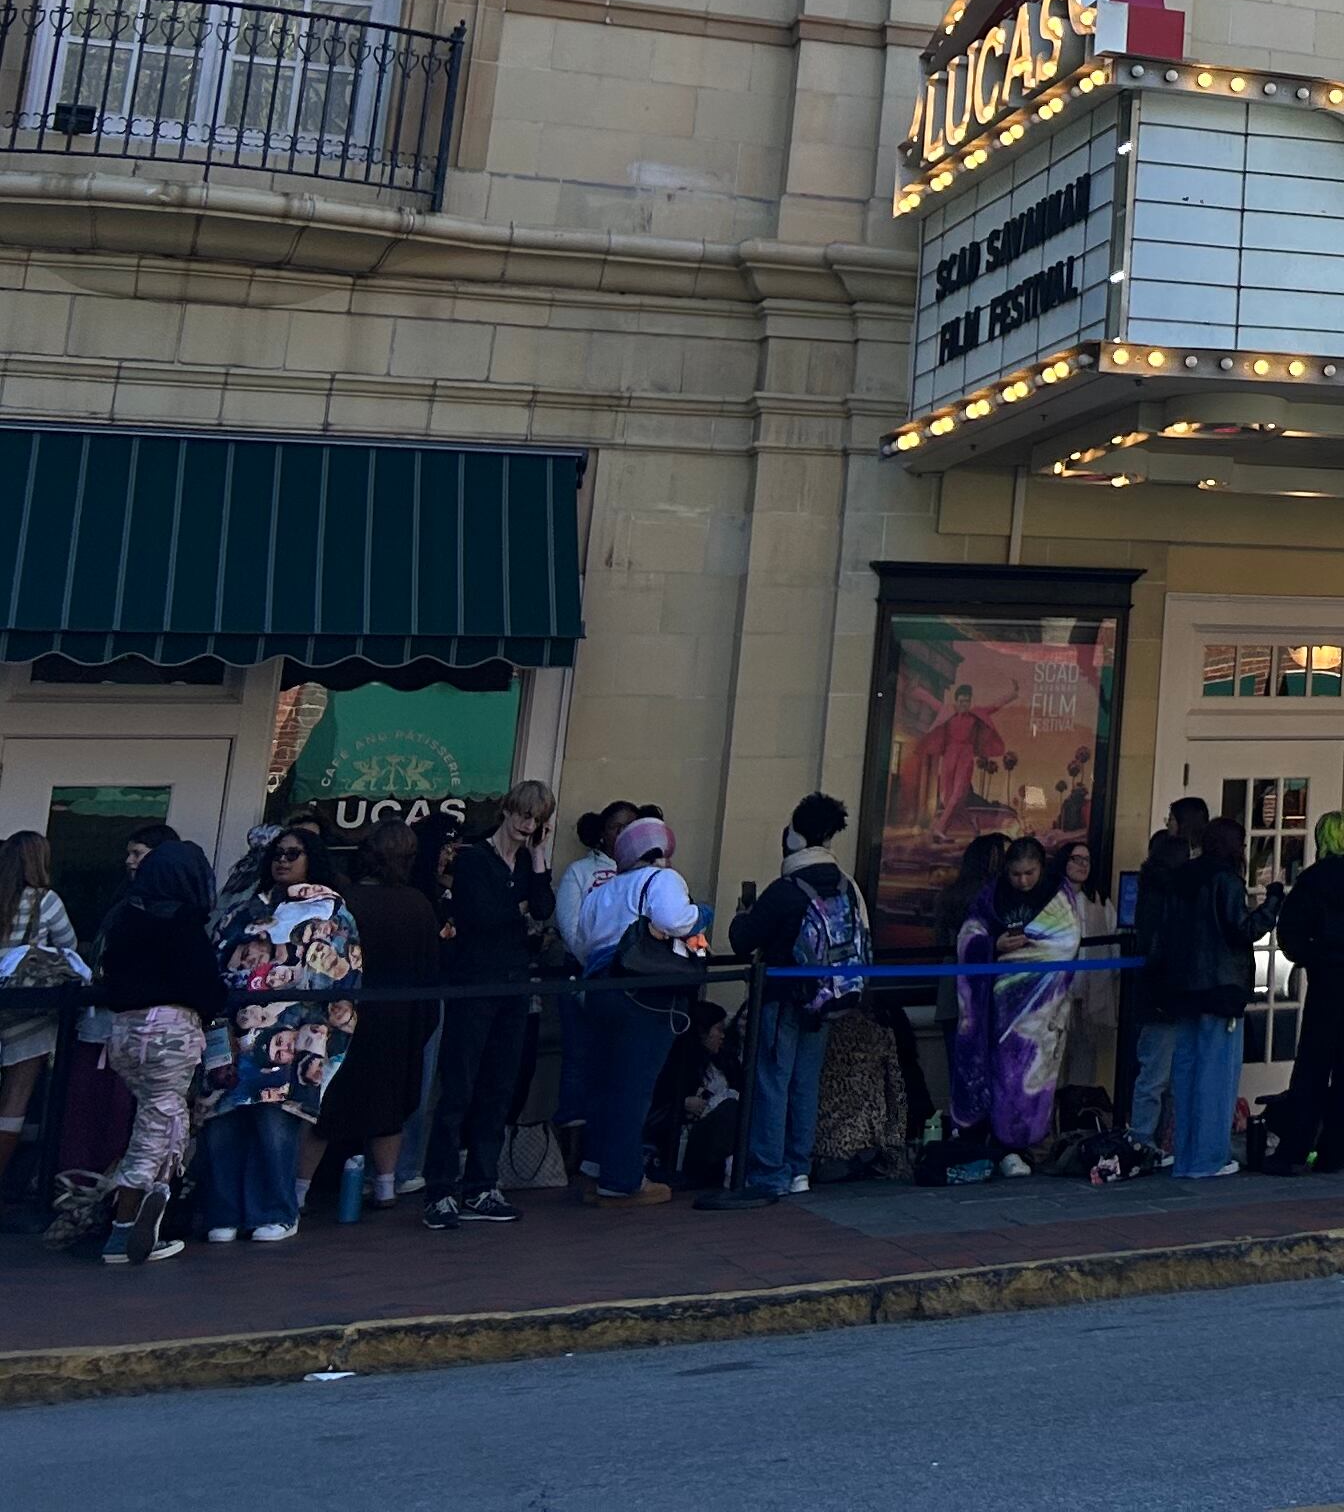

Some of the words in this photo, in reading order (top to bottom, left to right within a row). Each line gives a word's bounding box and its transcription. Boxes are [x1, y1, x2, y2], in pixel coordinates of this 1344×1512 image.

[936, 241, 981, 303] SCAD
[986, 172, 1091, 273] SAVANNAH
[939, 305, 981, 366] FILM
[988, 255, 1078, 343] FESTIVAL
[1034, 662, 1080, 683] SCAD
[1031, 693, 1077, 717] FILM
[355, 733, 389, 751] AND
[308, 799, 466, 829] UCAS
